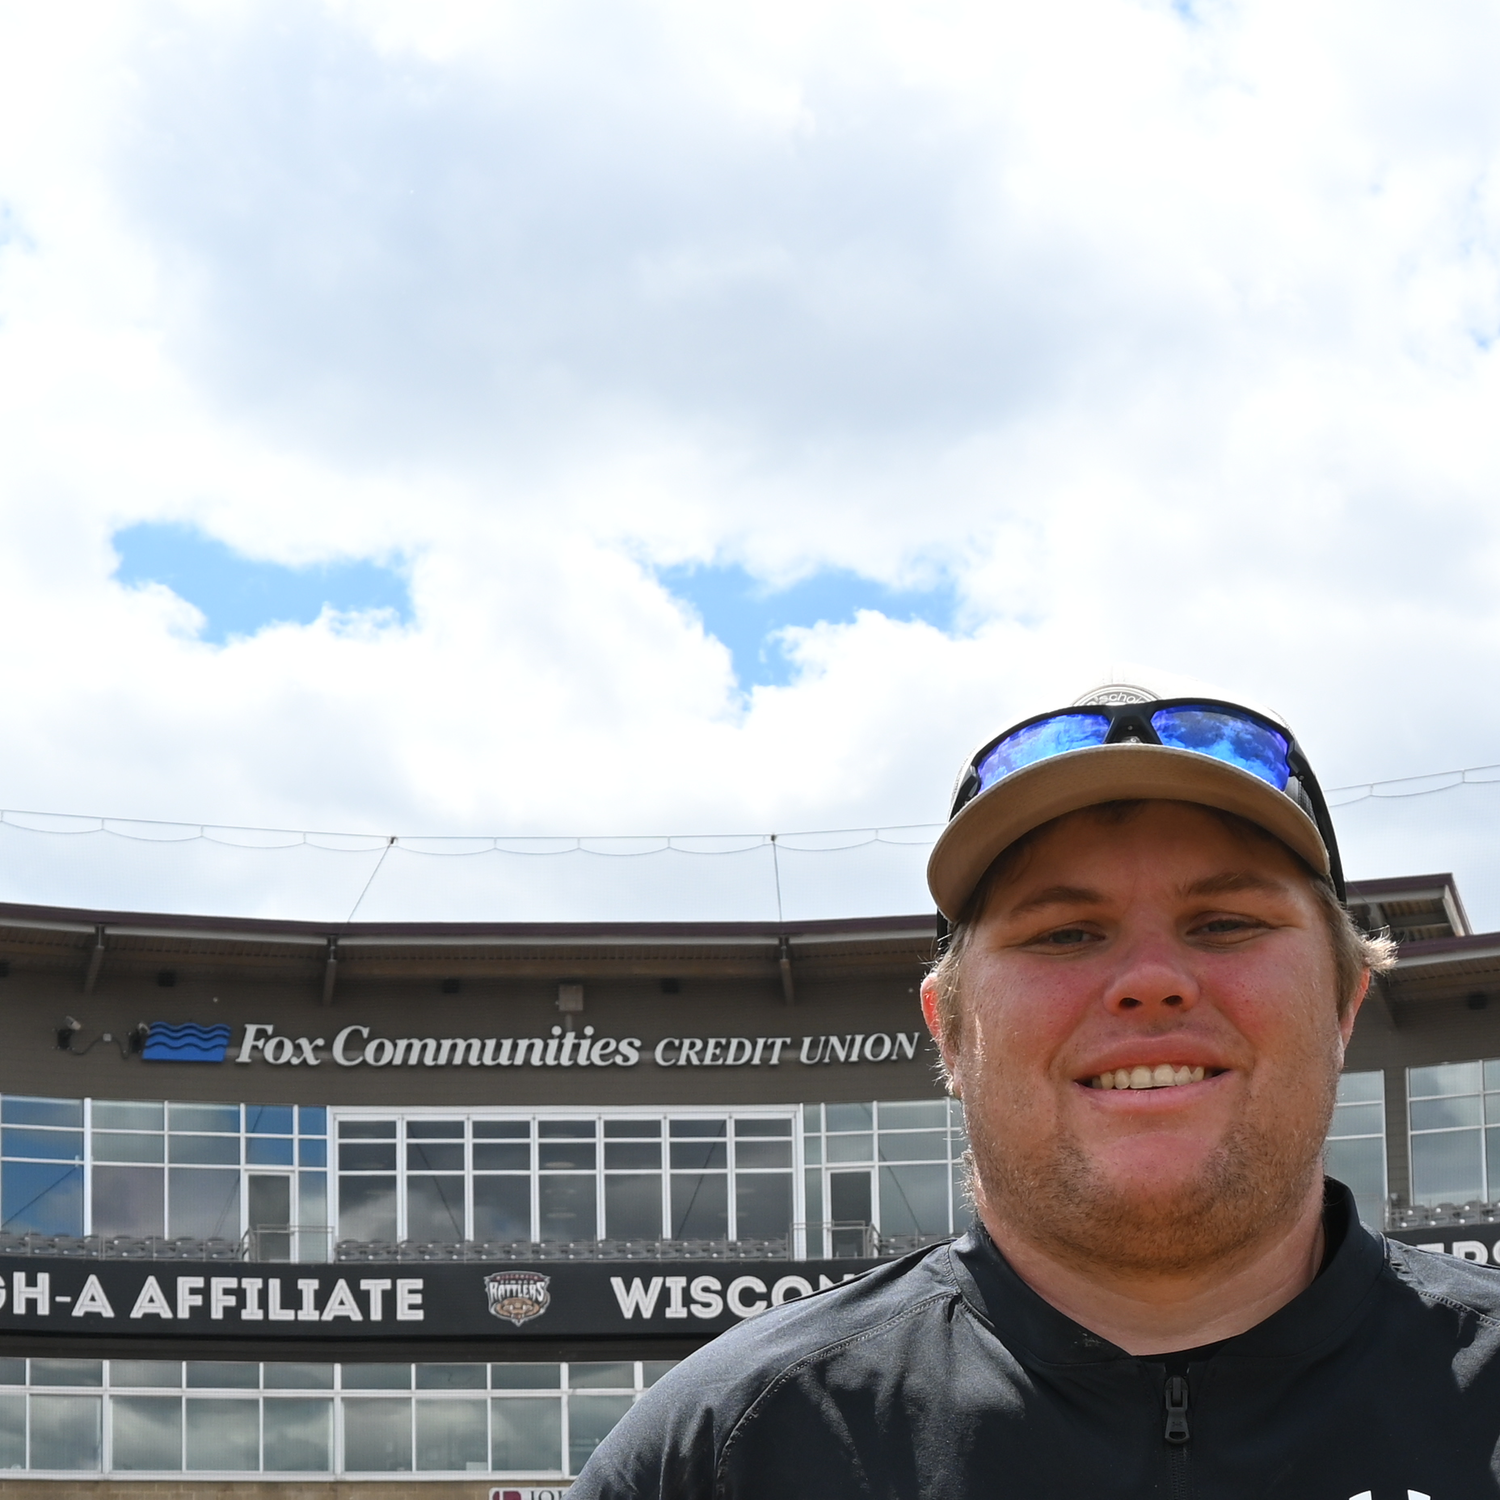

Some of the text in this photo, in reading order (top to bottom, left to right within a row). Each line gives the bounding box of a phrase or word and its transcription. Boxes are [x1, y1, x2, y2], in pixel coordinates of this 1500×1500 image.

[235, 1023, 921, 1067] Fox Communities CREDIT UNION
[129, 1275, 425, 1321] AFFILIATE
